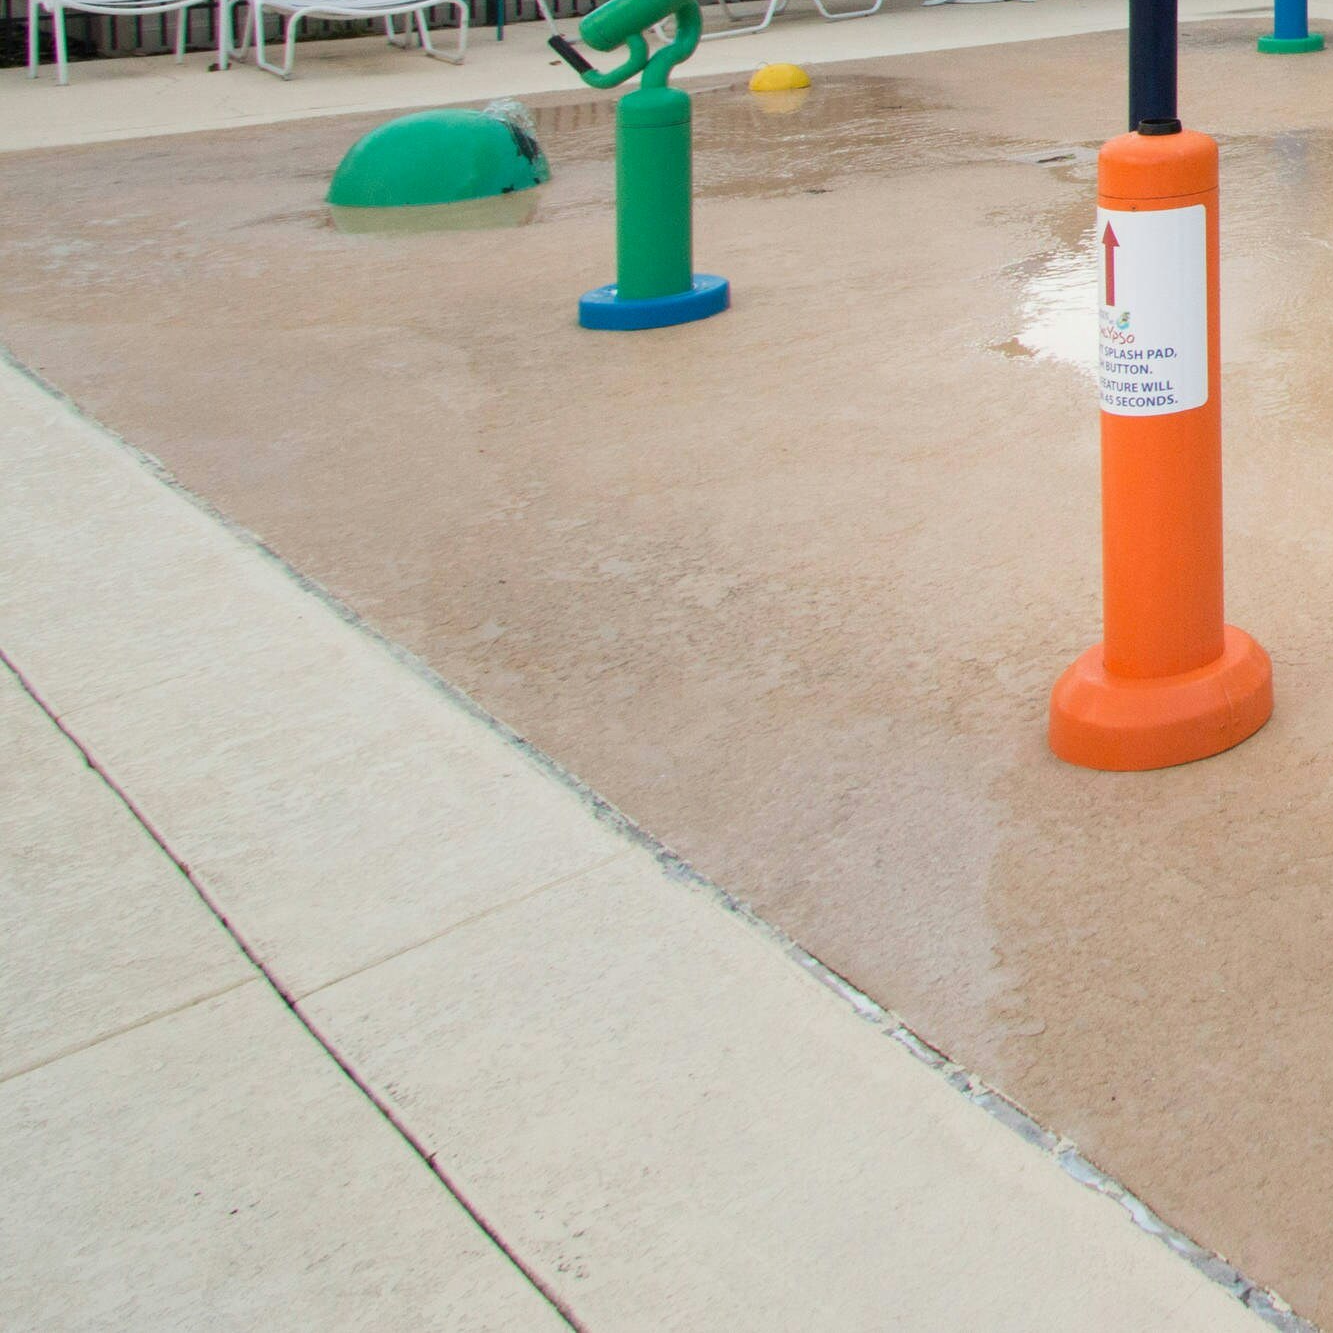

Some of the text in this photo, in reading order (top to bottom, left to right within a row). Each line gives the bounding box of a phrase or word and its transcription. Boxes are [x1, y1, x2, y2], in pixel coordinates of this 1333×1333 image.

[1104, 346, 1143, 360] SPLASH
[1147, 347, 1177, 359] PAD,
[1105, 361, 1153, 375] BUTTON.
[1141, 380, 1174, 392] WILL
[1115, 394, 1178, 407] SECONDS.
